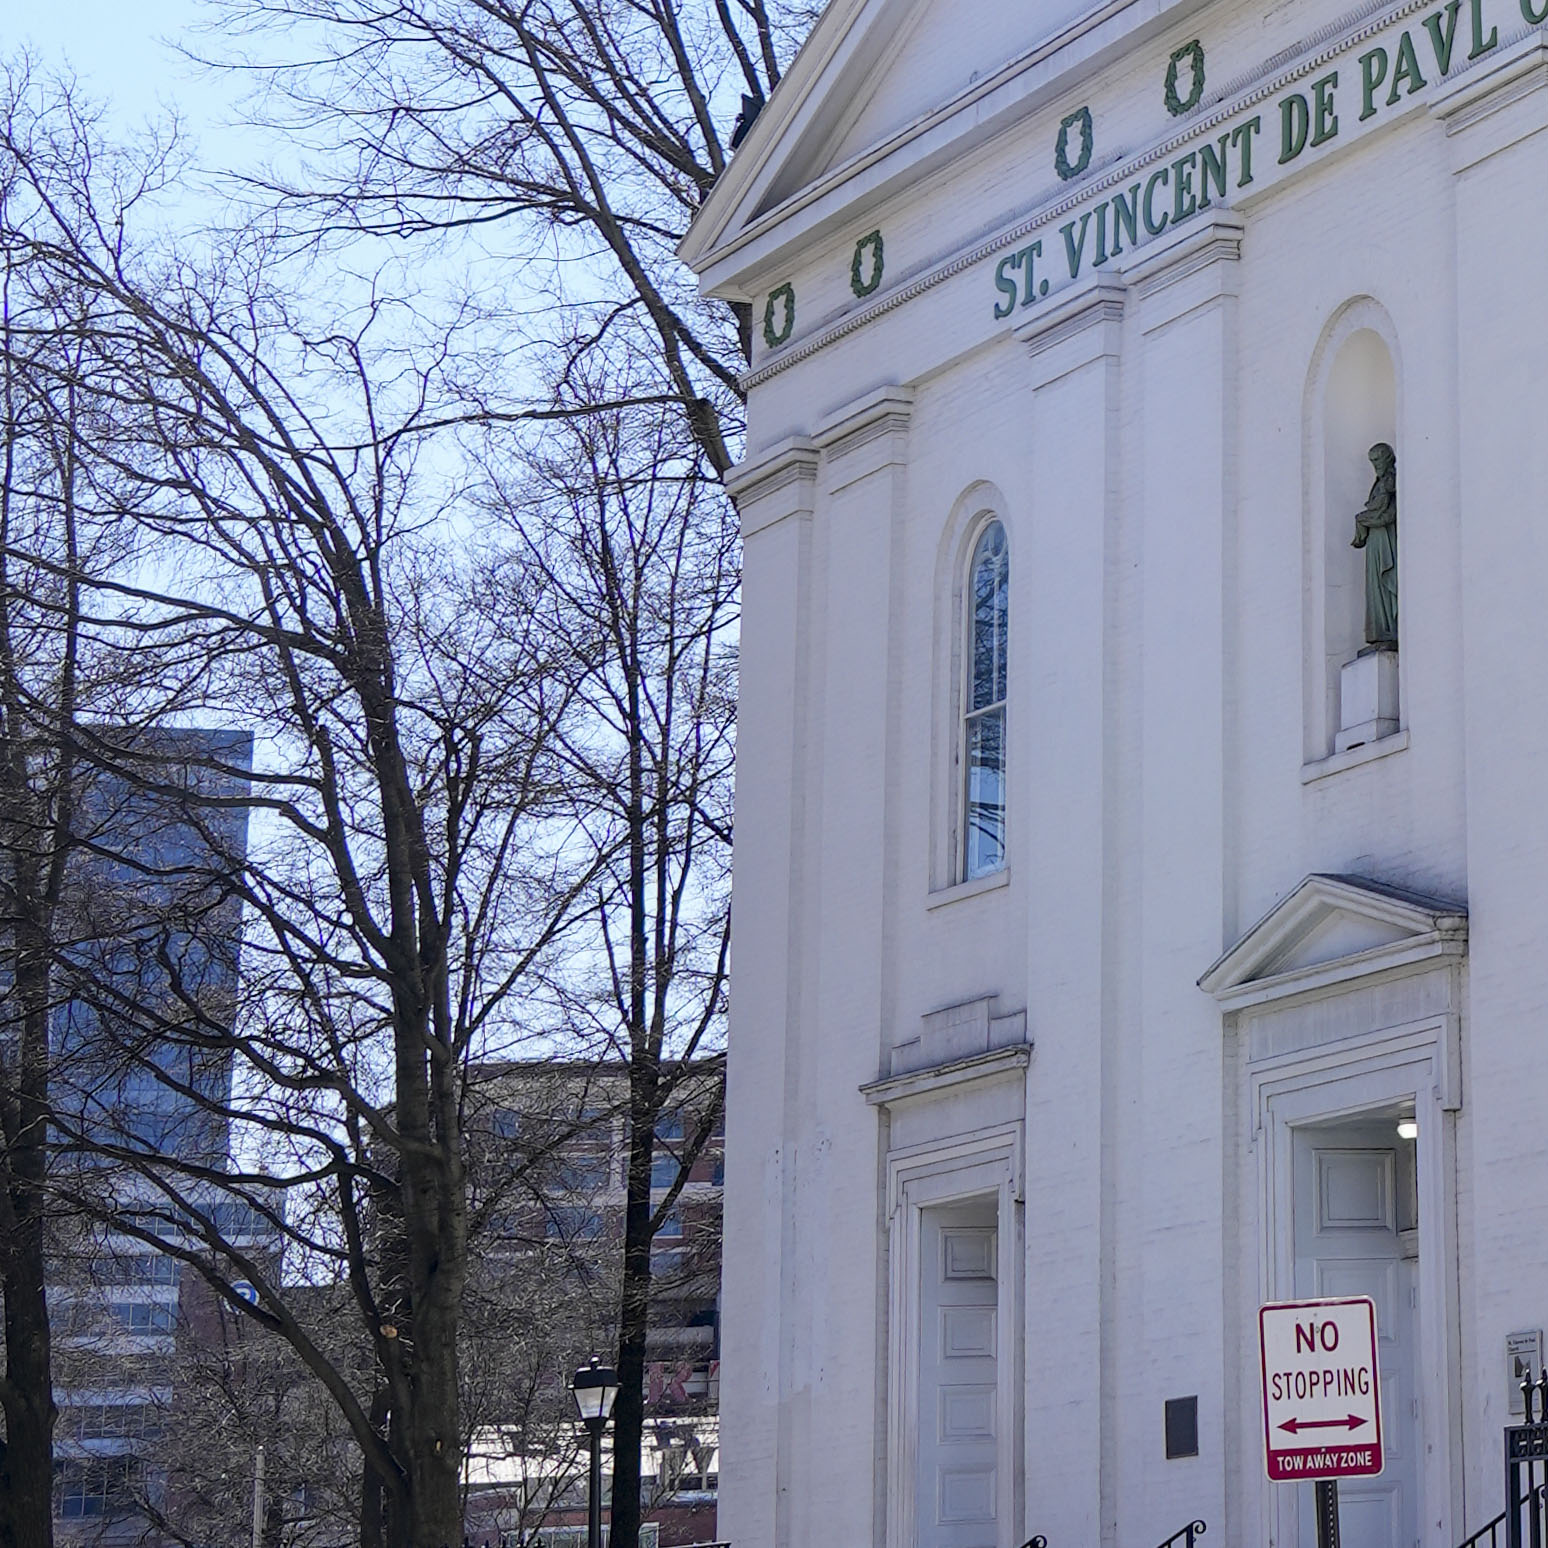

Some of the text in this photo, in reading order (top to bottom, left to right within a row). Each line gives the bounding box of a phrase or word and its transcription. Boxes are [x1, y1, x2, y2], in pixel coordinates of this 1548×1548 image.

[994, 239, 1049, 320] ST.
[1059, 115, 1260, 278] VINCENT
[1278, 70, 1339, 165] DE
[1295, 1320, 1339, 1354] NO
[1272, 1367, 1369, 1401] STOPPING
[1277, 1450, 1372, 1472] TOW AWAY ZONE
